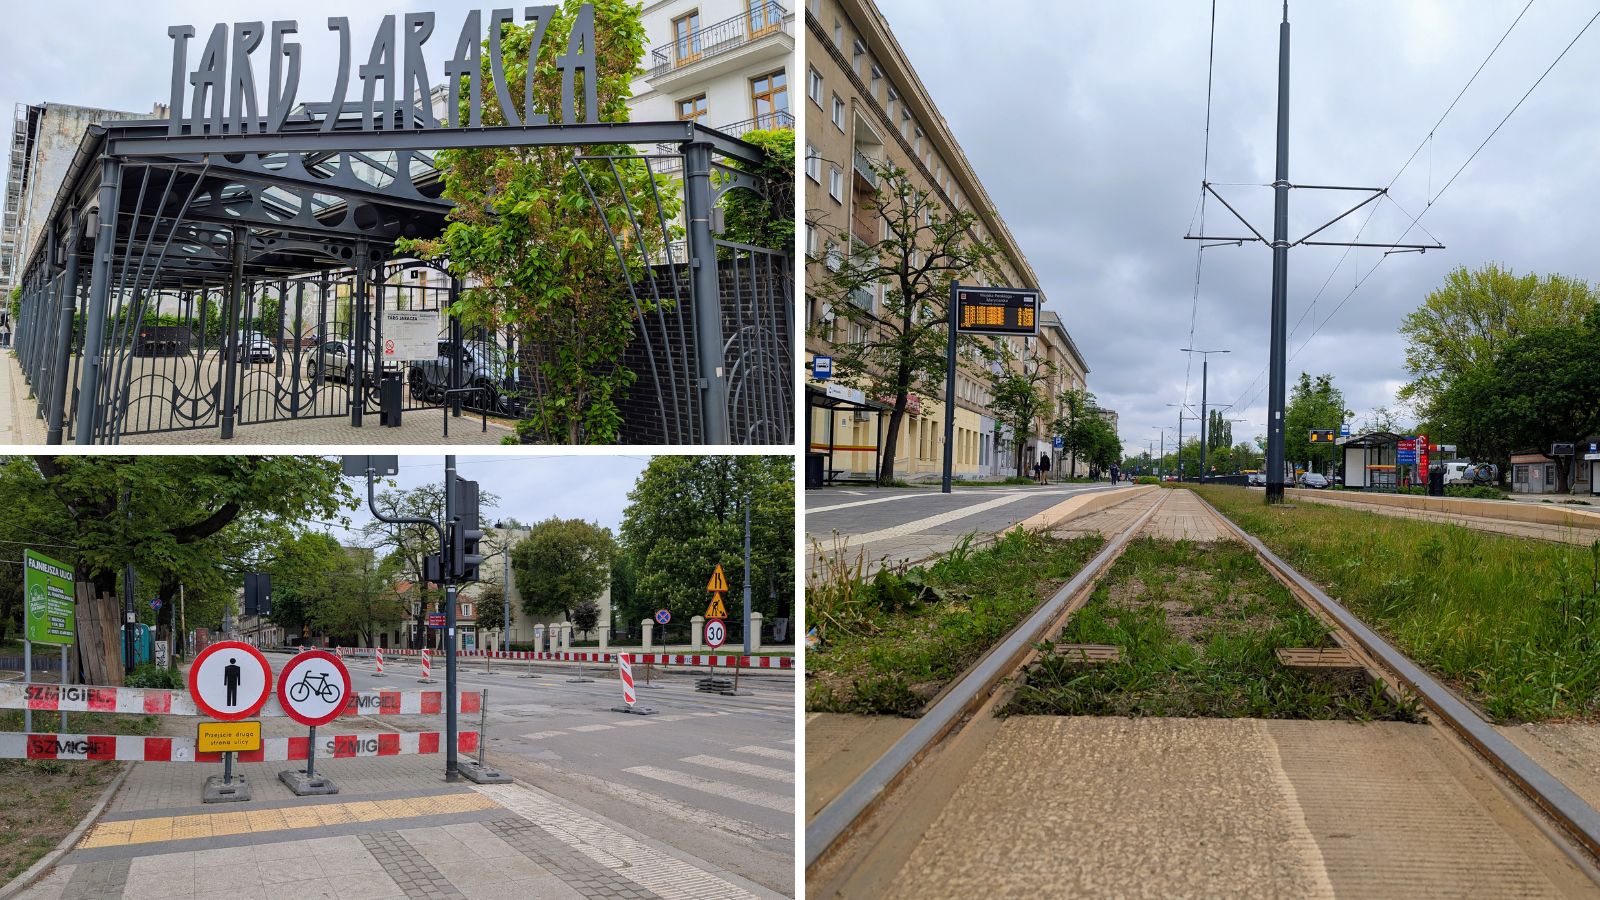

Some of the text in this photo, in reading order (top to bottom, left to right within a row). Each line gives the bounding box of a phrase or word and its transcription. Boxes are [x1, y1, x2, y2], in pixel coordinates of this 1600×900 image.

[168, 3, 600, 136] TARG JARACZA
[28, 558, 58, 576] FAJNIEJSZA
[708, 626, 723, 641] 30
[346, 695, 398, 709] ZMIGIEL
